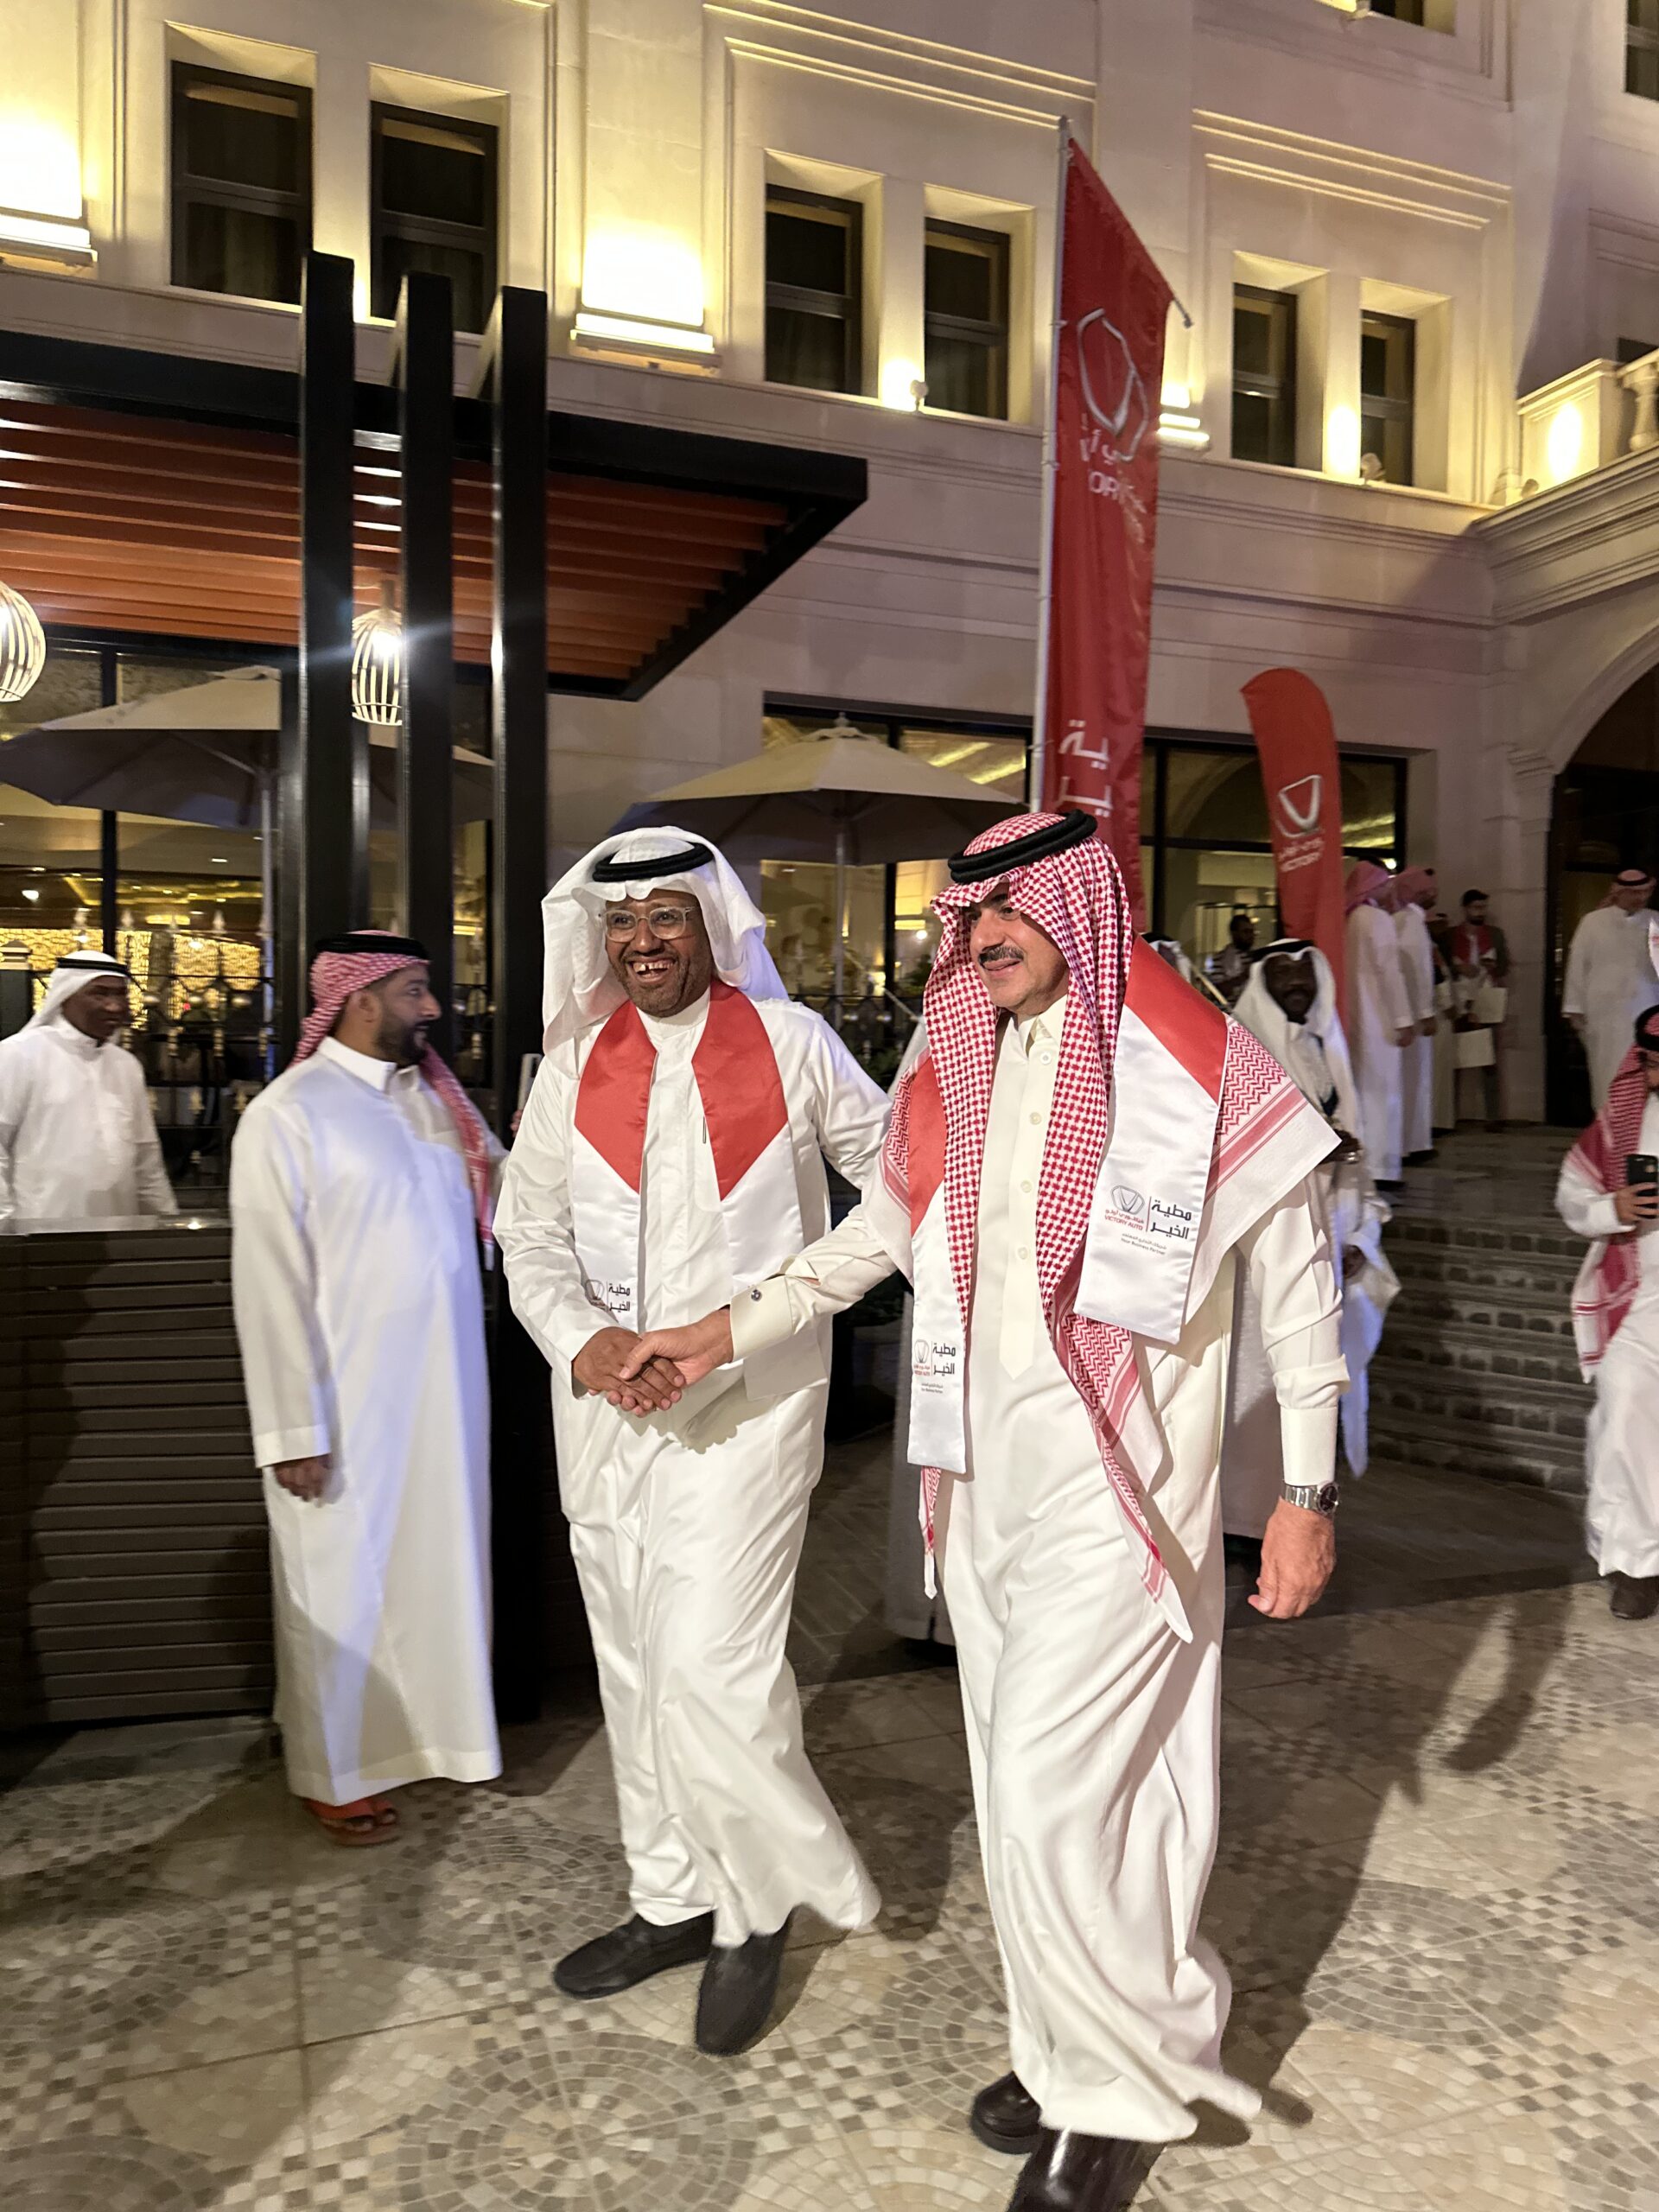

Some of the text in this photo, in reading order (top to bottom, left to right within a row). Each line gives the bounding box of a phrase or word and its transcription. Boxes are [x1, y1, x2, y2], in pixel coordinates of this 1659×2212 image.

[1151, 1199, 1192, 1221] مطية
[1105, 1215, 1143, 1230] VICTORY AUTO
[1150, 1222, 1190, 1239] الخير
[608, 1283, 631, 1296] مطية
[609, 1300, 631, 1313] الخير
[933, 1343, 956, 1357] مطية
[933, 1363, 955, 1376] الخير
